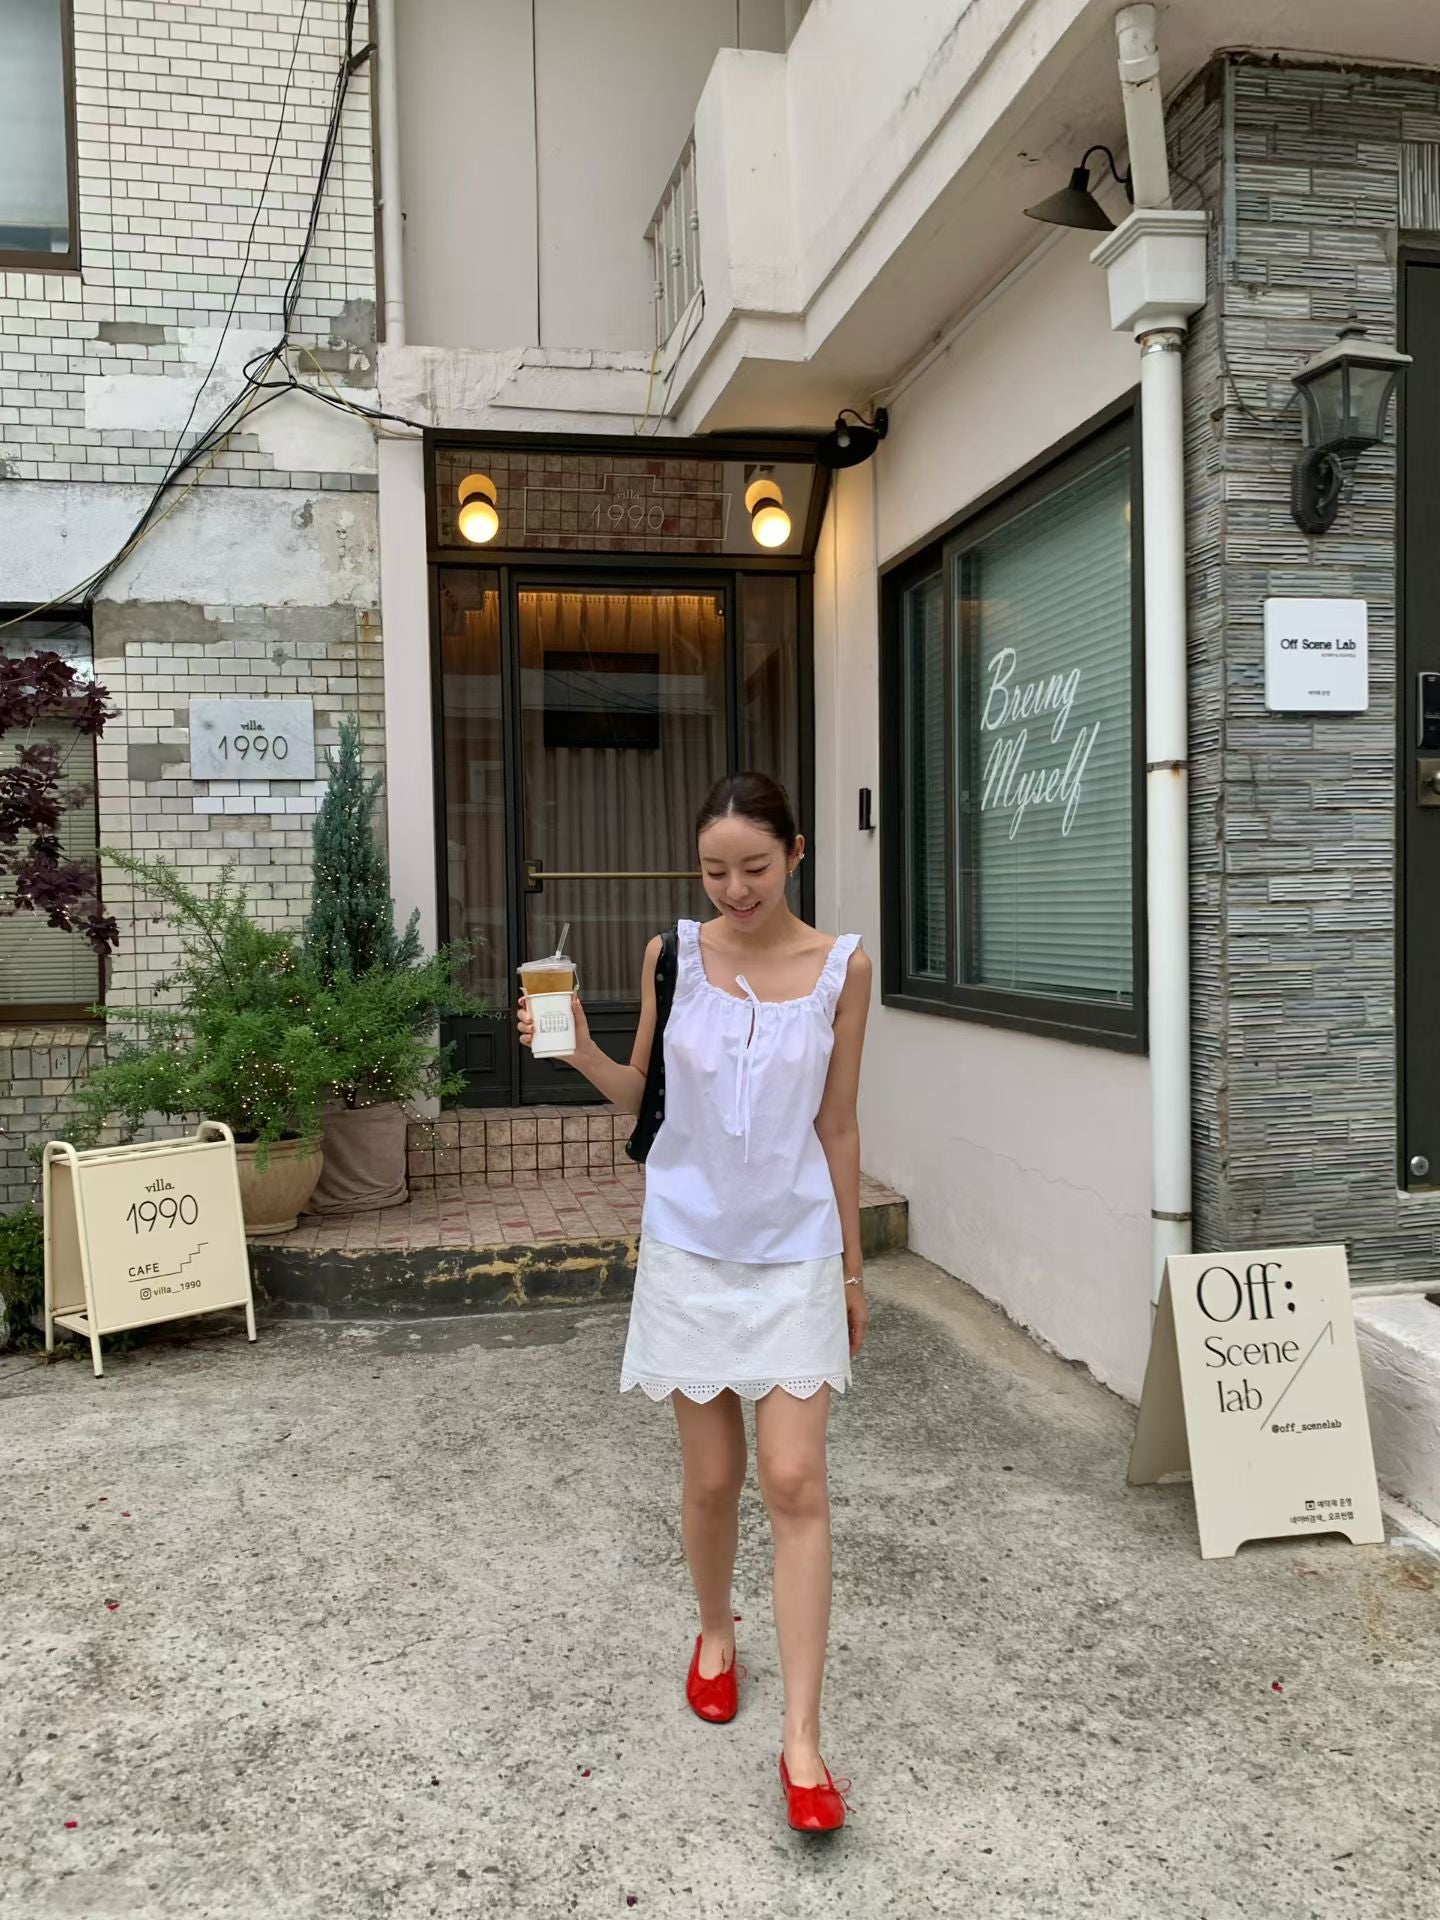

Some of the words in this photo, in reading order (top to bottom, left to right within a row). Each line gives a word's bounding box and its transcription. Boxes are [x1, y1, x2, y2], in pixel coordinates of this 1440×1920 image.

[591, 504, 665, 529] 1990
[1280, 639, 1298, 649] Off
[1302, 639, 1332, 649] Scene
[1336, 639, 1356, 650] Lab
[218, 735, 288, 760] 1990
[981, 721, 1101, 840] Myself
[126, 1194, 198, 1234] 1990
[128, 1262, 160, 1277] CAFE
[1205, 1336, 1300, 1368] Scene
[1217, 1379, 1263, 1413] lab
[1271, 1419, 1342, 1434] @off_scenelab
